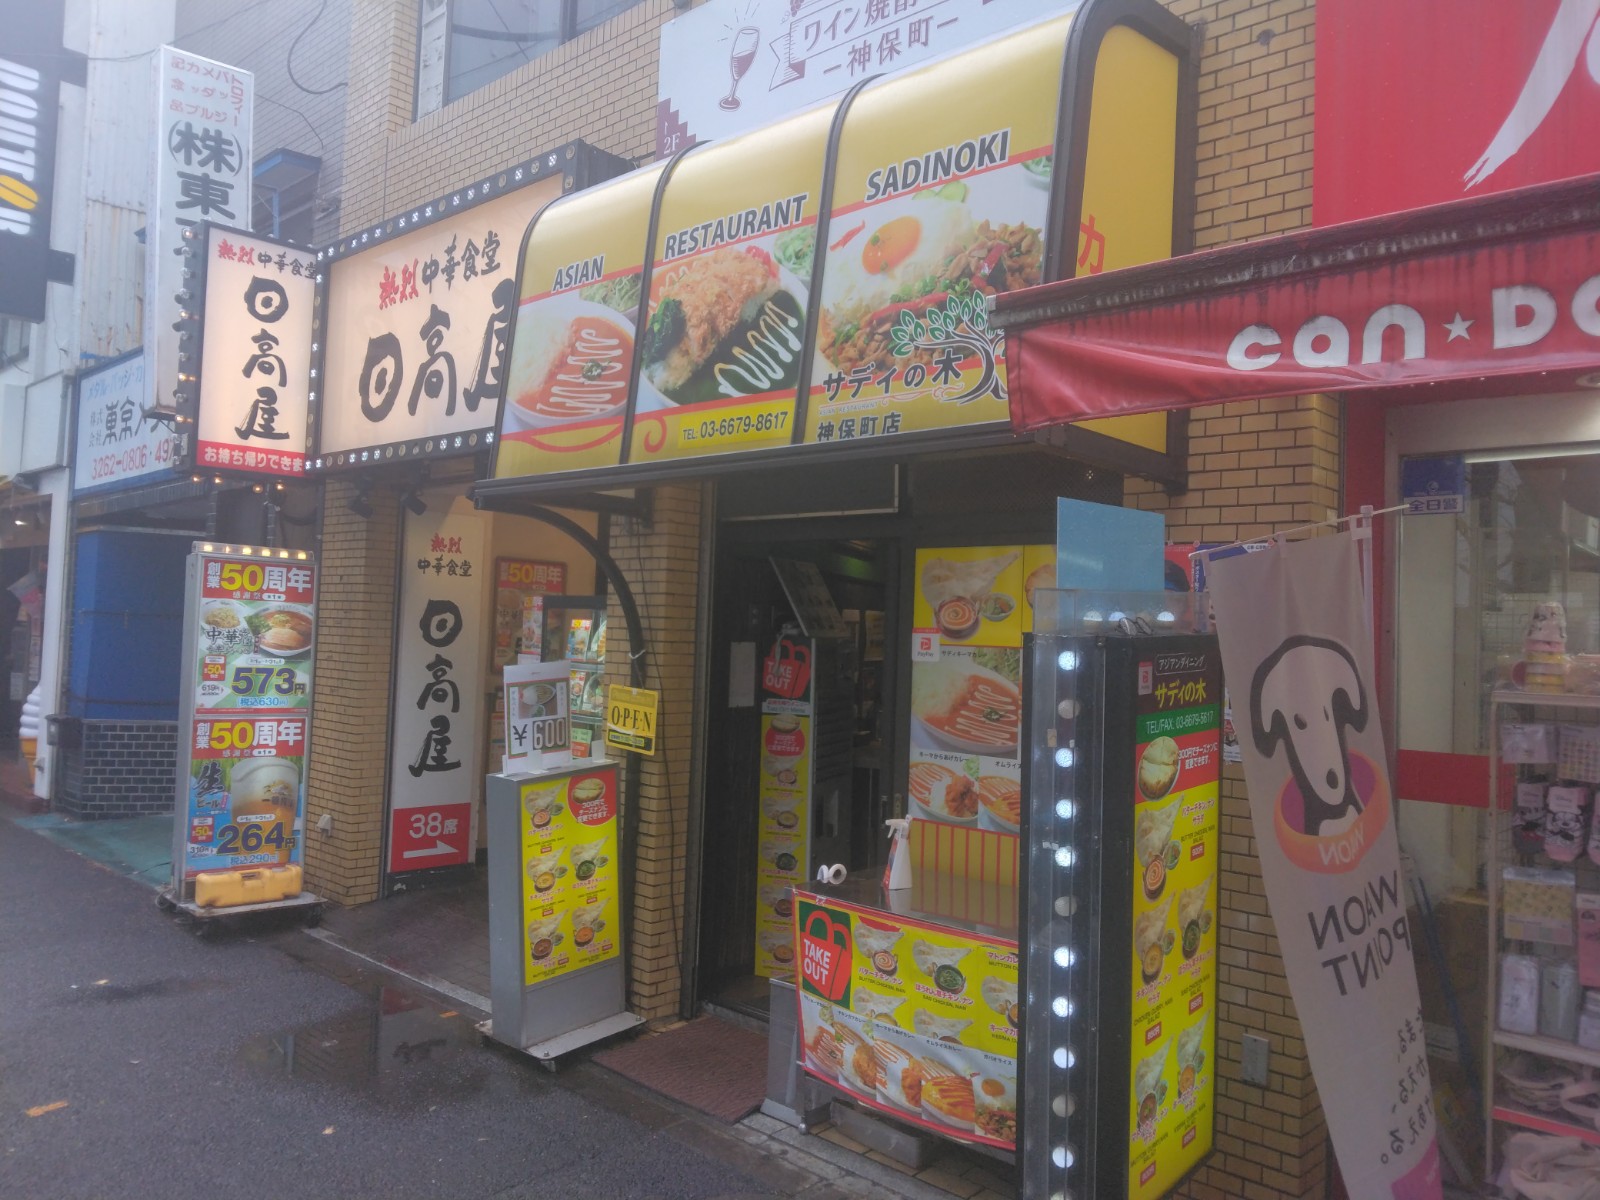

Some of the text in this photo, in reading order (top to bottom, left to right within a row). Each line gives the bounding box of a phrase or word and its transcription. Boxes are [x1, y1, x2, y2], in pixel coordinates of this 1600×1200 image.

[663, 135, 680, 154] 2F
[865, 129, 1009, 200] SADINOKI
[664, 193, 807, 260] RESTAURANT
[552, 256, 605, 292] ASIAN
[234, 275, 290, 441] 日高屋
[823, 349, 963, 401] サディの木
[700, 411, 788, 438] 03-6679-8617
[816, 411, 903, 443] 神保町店
[221, 564, 312, 593] 50周年
[417, 554, 473, 578] 中華食堂
[408, 598, 462, 777] 日高屋
[766, 675, 791, 690] OUT
[1155, 677, 1207, 708] サディの木
[210, 721, 302, 749] 50周年
[803, 938, 831, 969] TAKE
[804, 958, 829, 985] OUT
